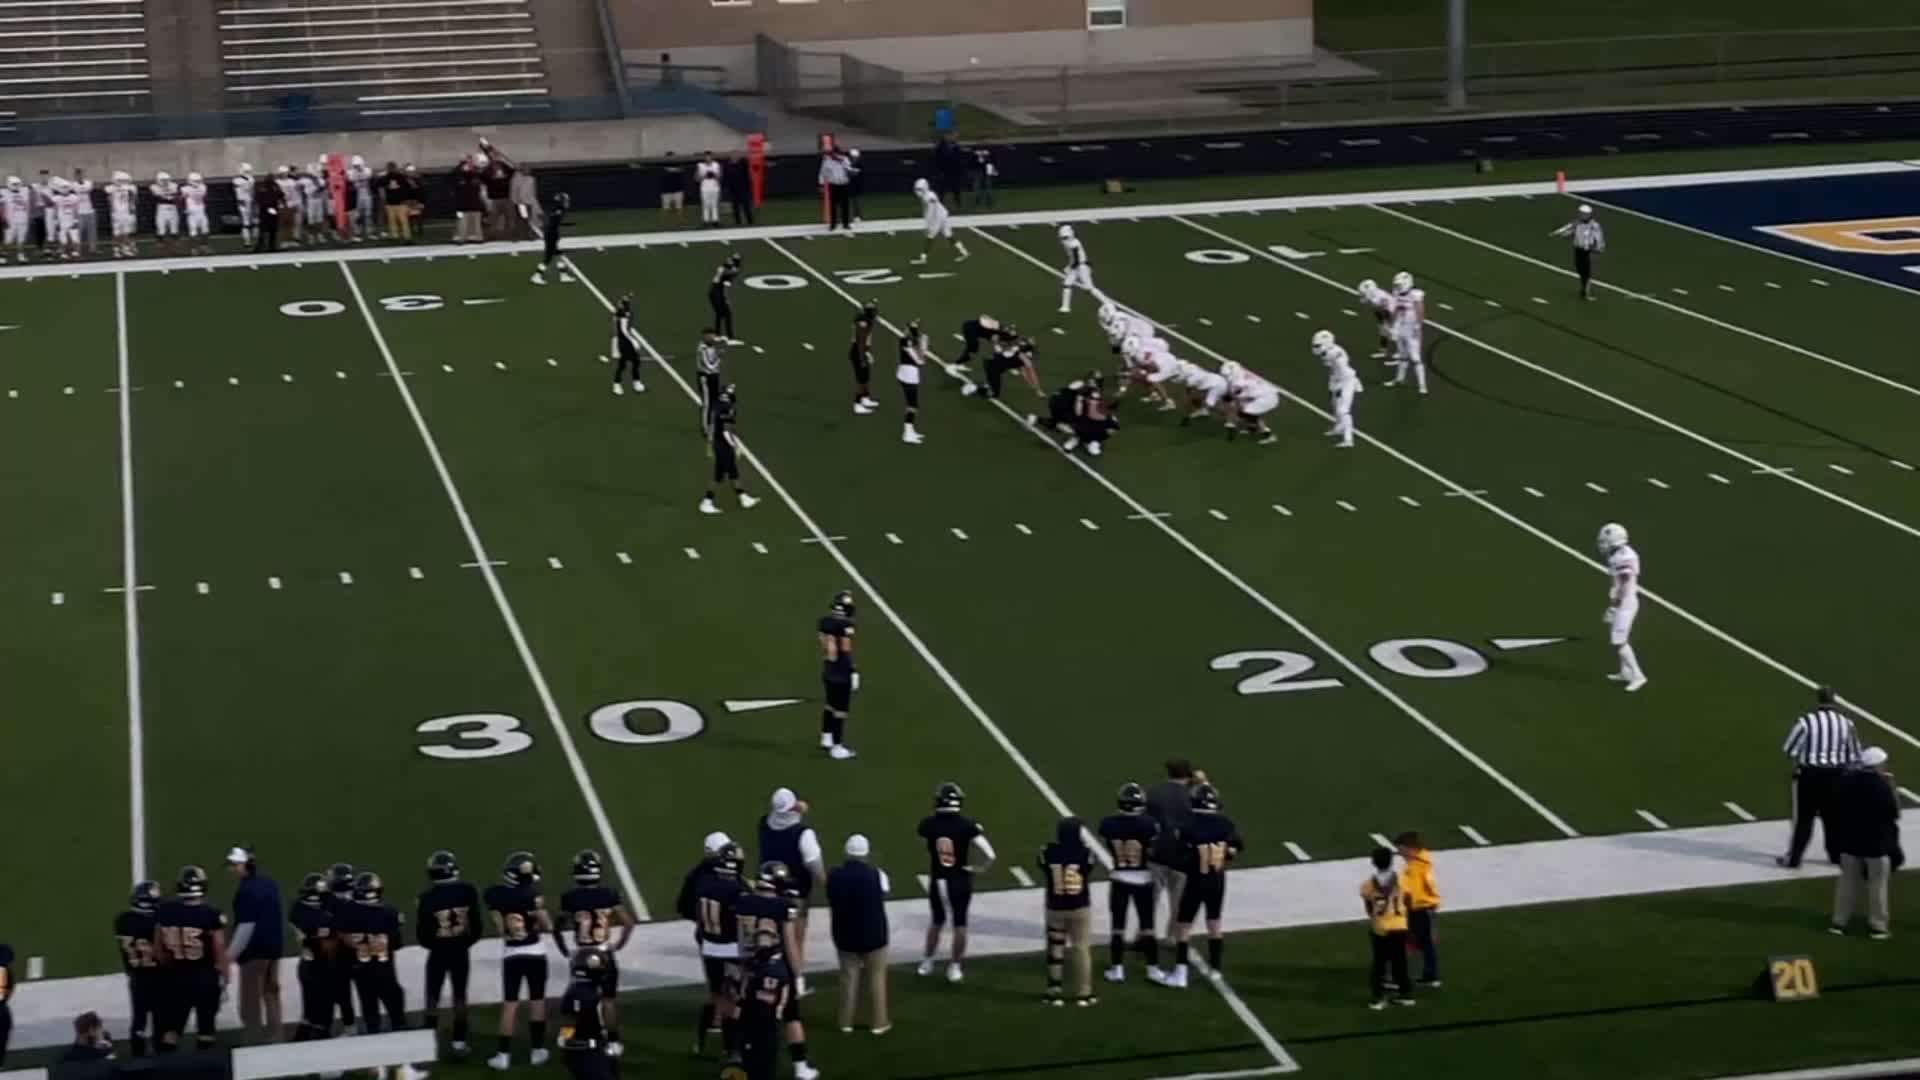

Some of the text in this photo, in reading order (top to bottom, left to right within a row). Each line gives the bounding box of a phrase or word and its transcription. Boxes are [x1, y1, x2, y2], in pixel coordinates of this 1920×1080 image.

[1209, 638, 1489, 695] 20
[416, 699, 704, 759] 30
[1771, 958, 1817, 995] 20
